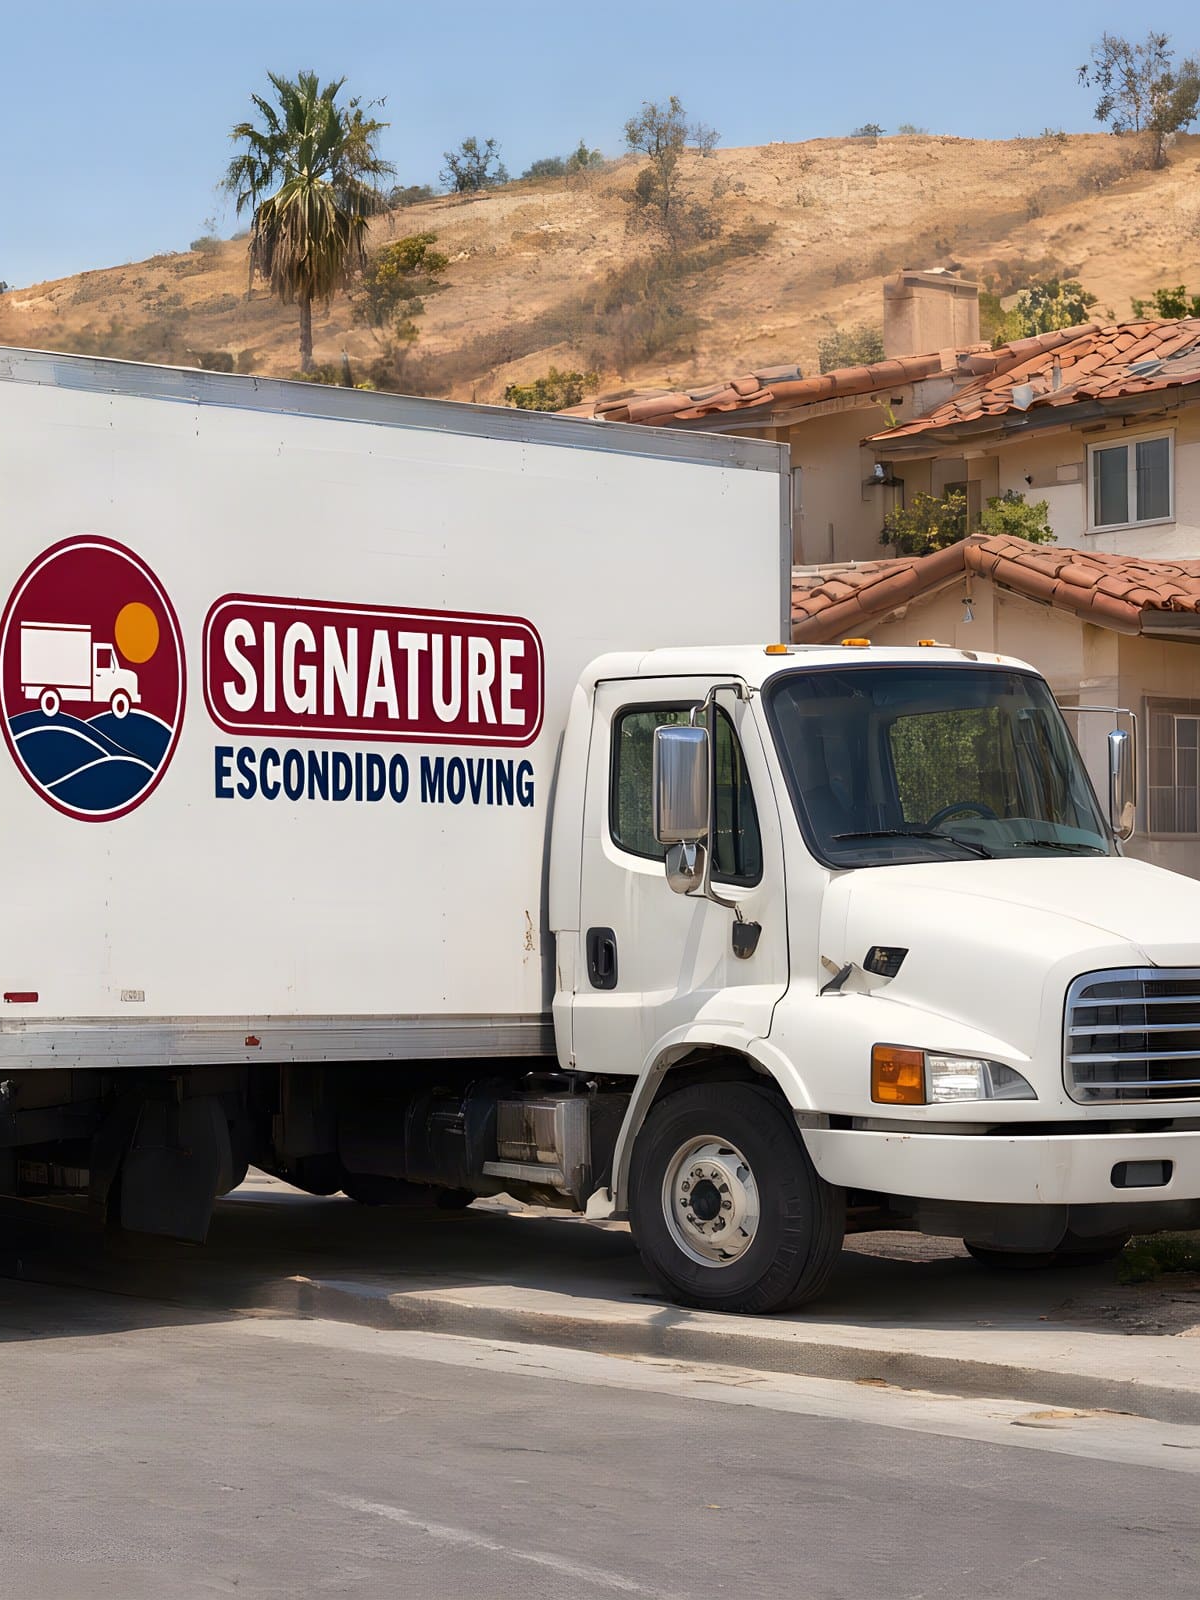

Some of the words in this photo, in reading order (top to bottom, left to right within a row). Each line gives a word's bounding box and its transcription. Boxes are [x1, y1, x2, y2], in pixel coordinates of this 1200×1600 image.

[222, 618, 526, 726] SIGNATURE
[214, 745, 410, 804] ESCONDIDO
[420, 755, 535, 808] MOVING
